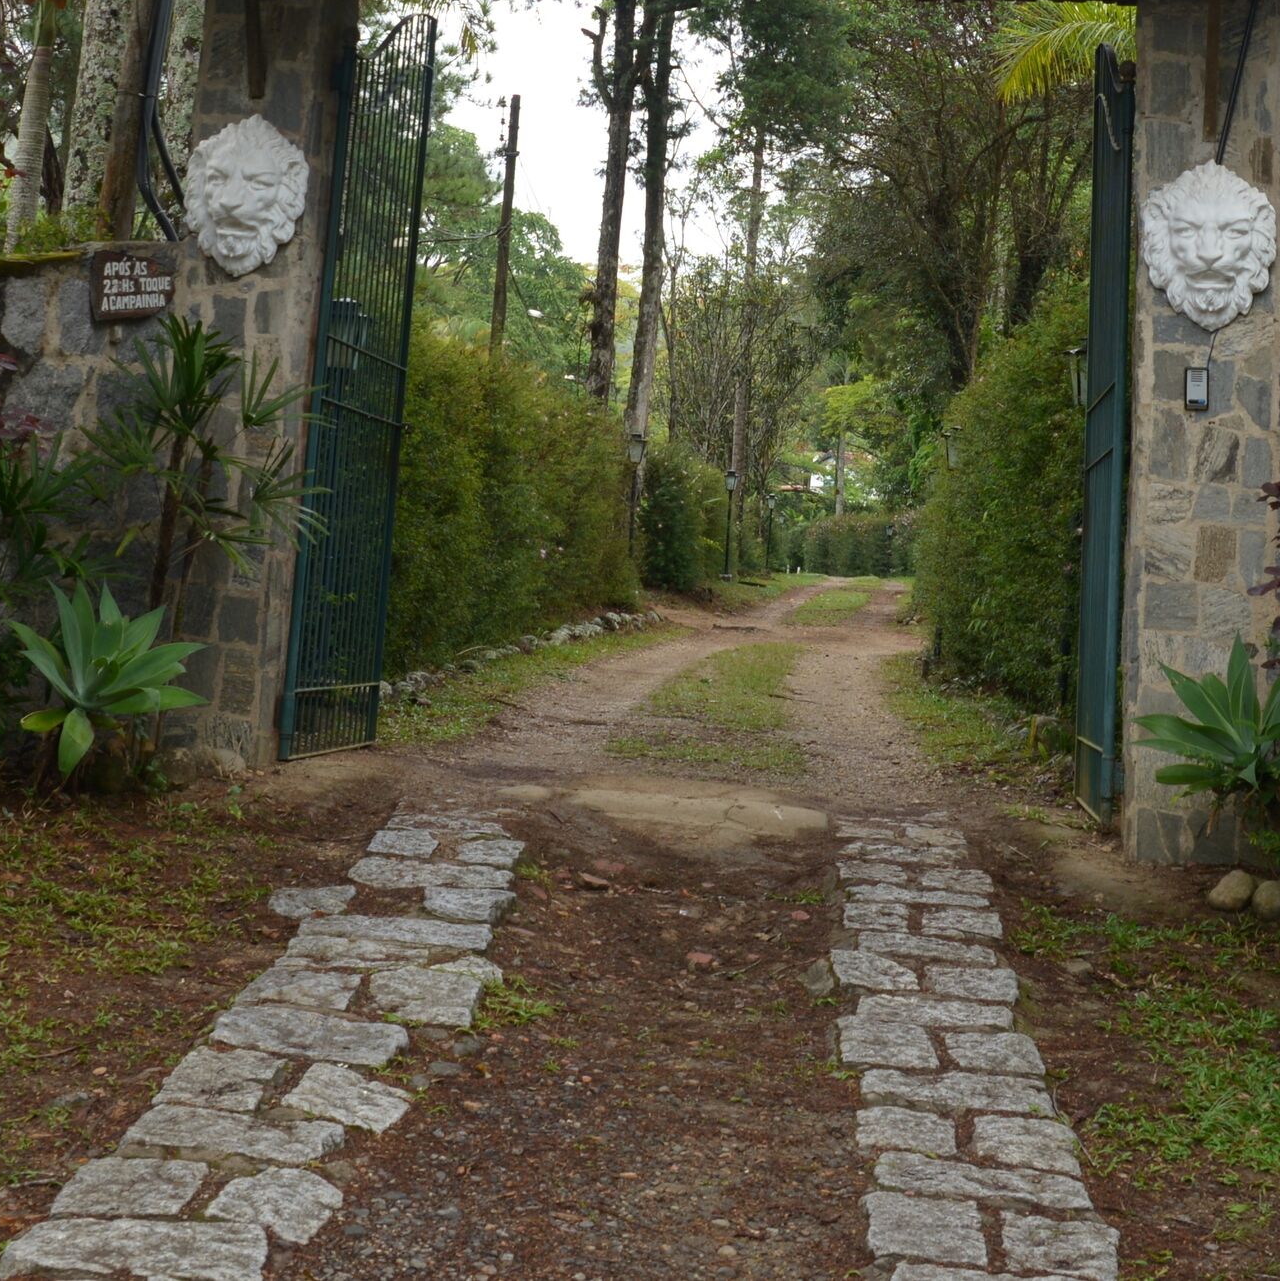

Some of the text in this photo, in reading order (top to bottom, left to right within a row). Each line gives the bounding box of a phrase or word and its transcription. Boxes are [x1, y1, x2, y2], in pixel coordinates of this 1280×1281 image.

[104, 257, 131, 276] APÓS
[139, 276, 171, 291] TOQUE
[101, 294, 165, 311] A CAMPAINHA
